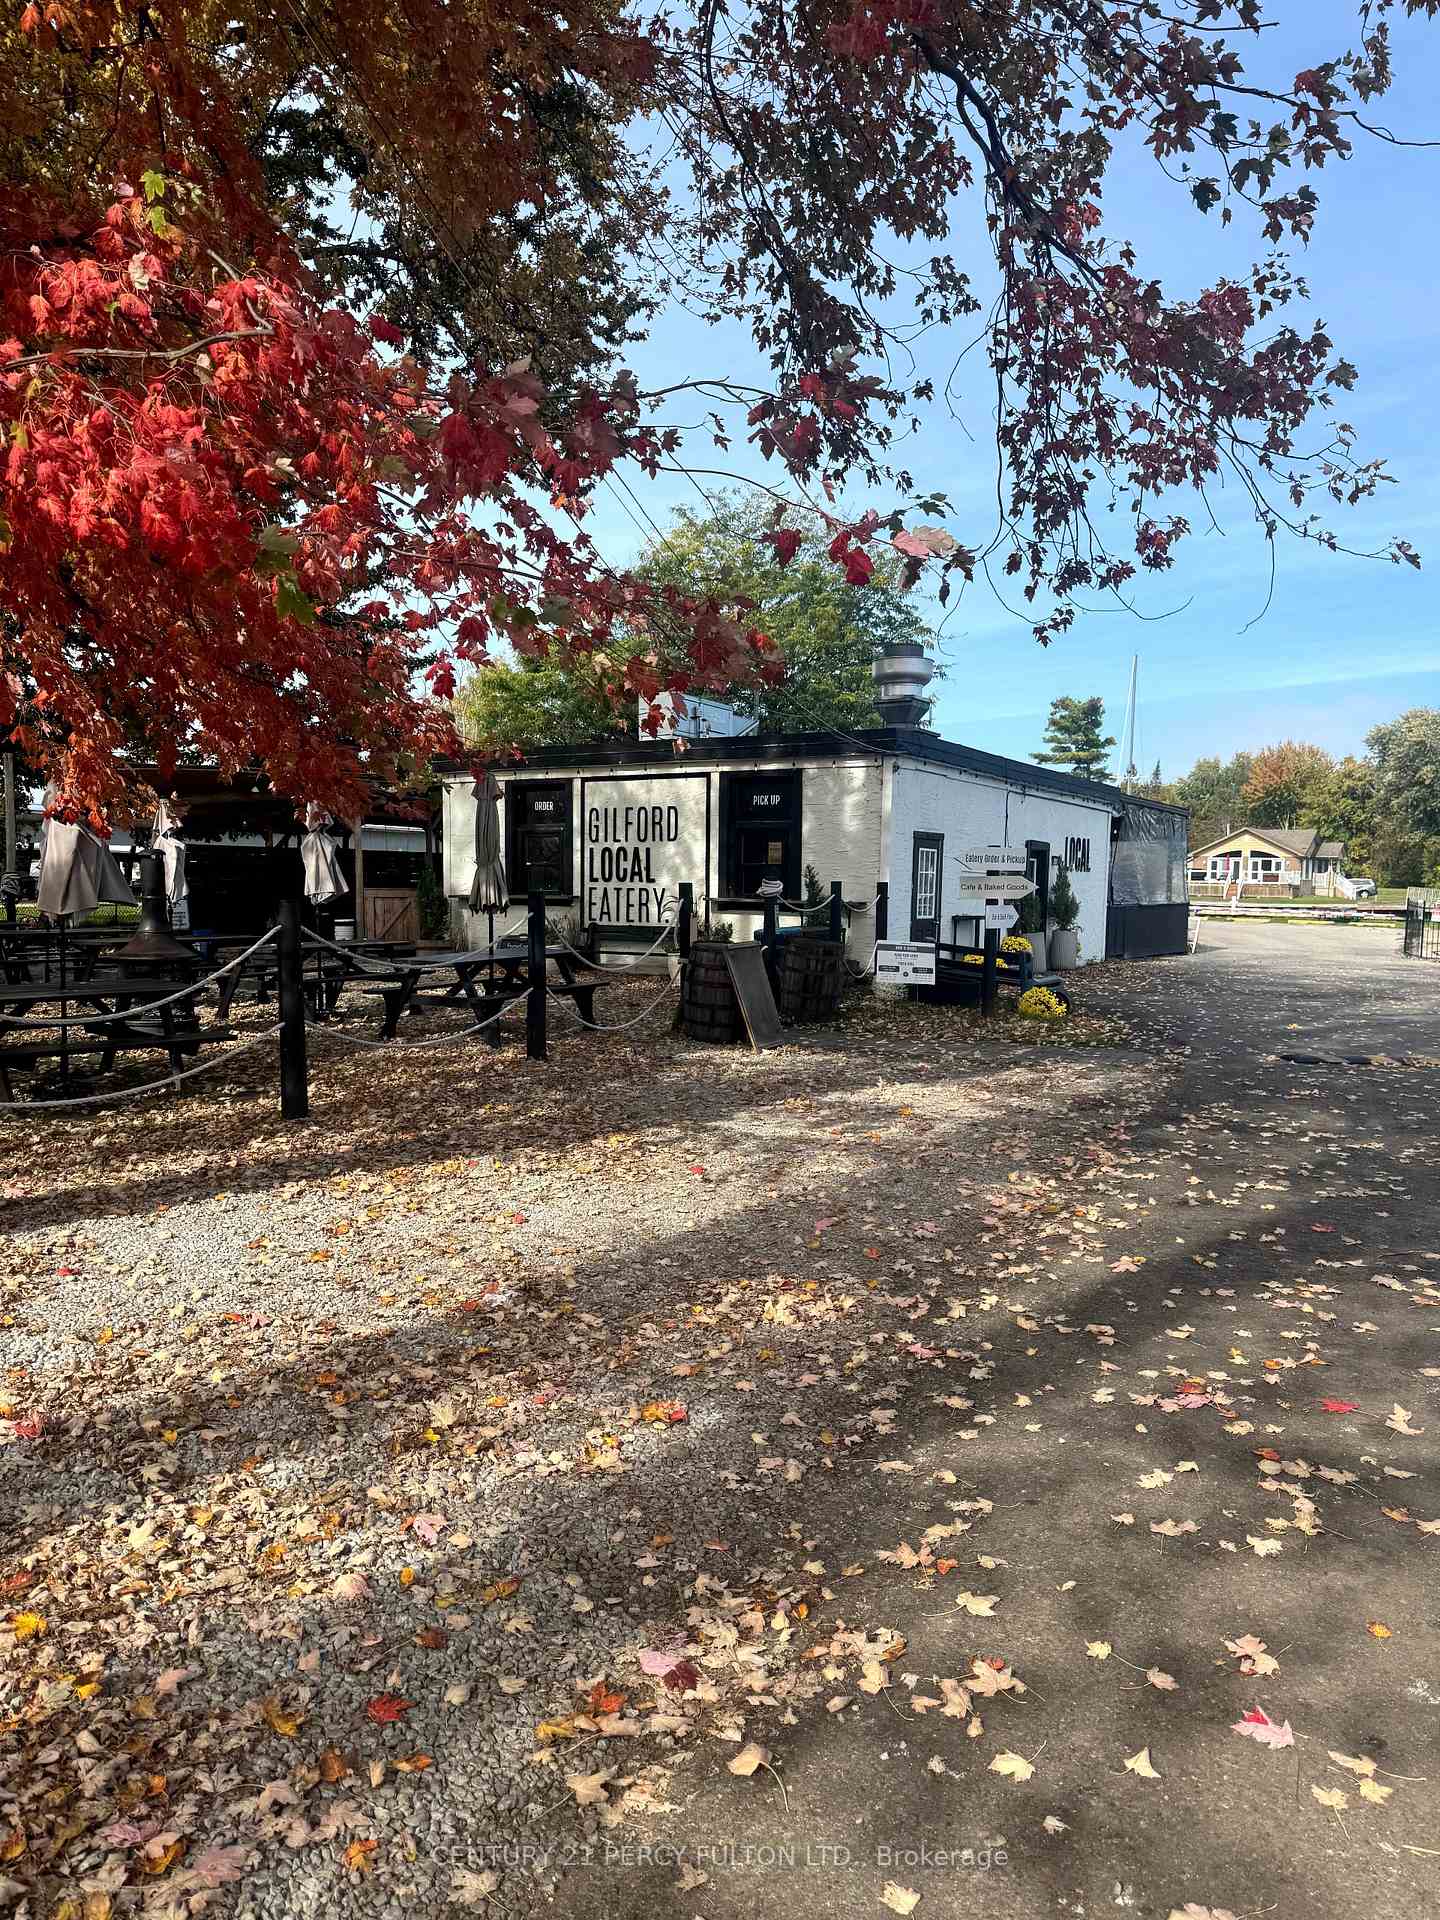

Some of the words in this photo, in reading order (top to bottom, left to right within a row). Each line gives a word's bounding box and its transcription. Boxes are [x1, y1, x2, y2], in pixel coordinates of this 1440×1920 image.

[534, 801, 553, 811] ORDER
[753, 794, 769, 806] PICK
[770, 794, 781, 806] UP
[588, 806, 679, 843] GILFORD
[965, 854, 984, 864] Eatery
[1006, 854, 1026, 865] Pickup
[1064, 836, 1091, 872] LOCAL
[588, 846, 656, 883] LOCAL
[984, 882, 1005, 891] Baked
[1006, 883, 1028, 892] Goods
